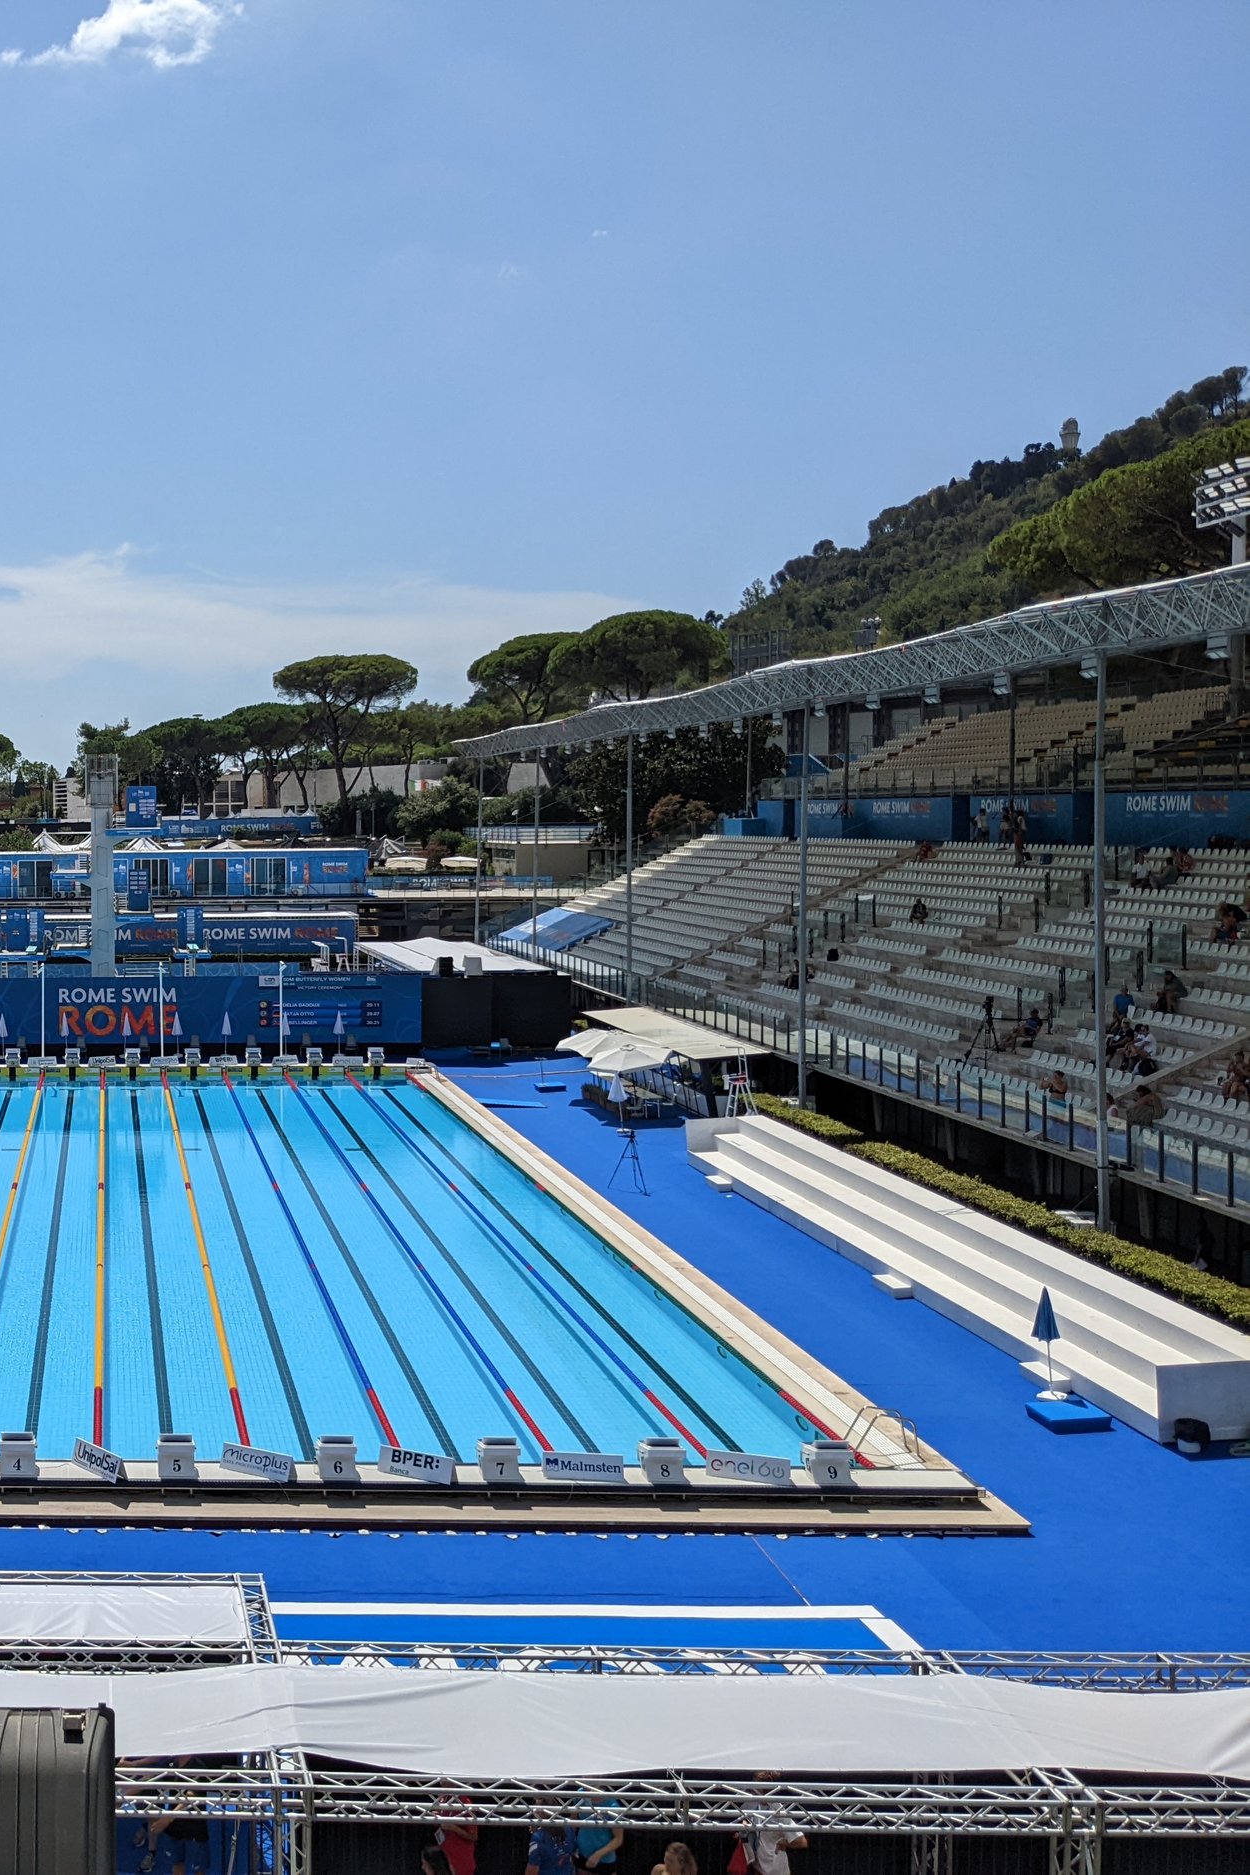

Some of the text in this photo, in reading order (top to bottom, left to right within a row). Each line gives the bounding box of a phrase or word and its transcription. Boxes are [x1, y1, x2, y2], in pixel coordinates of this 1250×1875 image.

[822, 802, 838, 814] SWIM
[872, 802, 890, 814] ROME
[892, 801, 910, 813] SWIM
[981, 799, 1004, 812] ROME
[1126, 795, 1229, 812] ROME SWIM ROME
[246, 823, 270, 832] SWIM
[44, 929, 78, 942] ROM
[202, 927, 338, 940] ROME SWIM ROME
[58, 988, 177, 1003] ROME SWIM
[58, 1004, 178, 1037] ROME
[12, 1457, 22, 1471] 4
[78, 1441, 119, 1475] UnipolSai
[391, 1449, 440, 1471] BPER:
[173, 1459, 181, 1472] 5
[333, 1460, 343, 1474] 6
[389, 1465, 409, 1475] Banca
[495, 1462, 504, 1475] 7
[560, 1459, 622, 1475] Malmsten
[660, 1464, 671, 1478] 8
[710, 1458, 754, 1476] enel
[827, 1465, 838, 1479] 9
